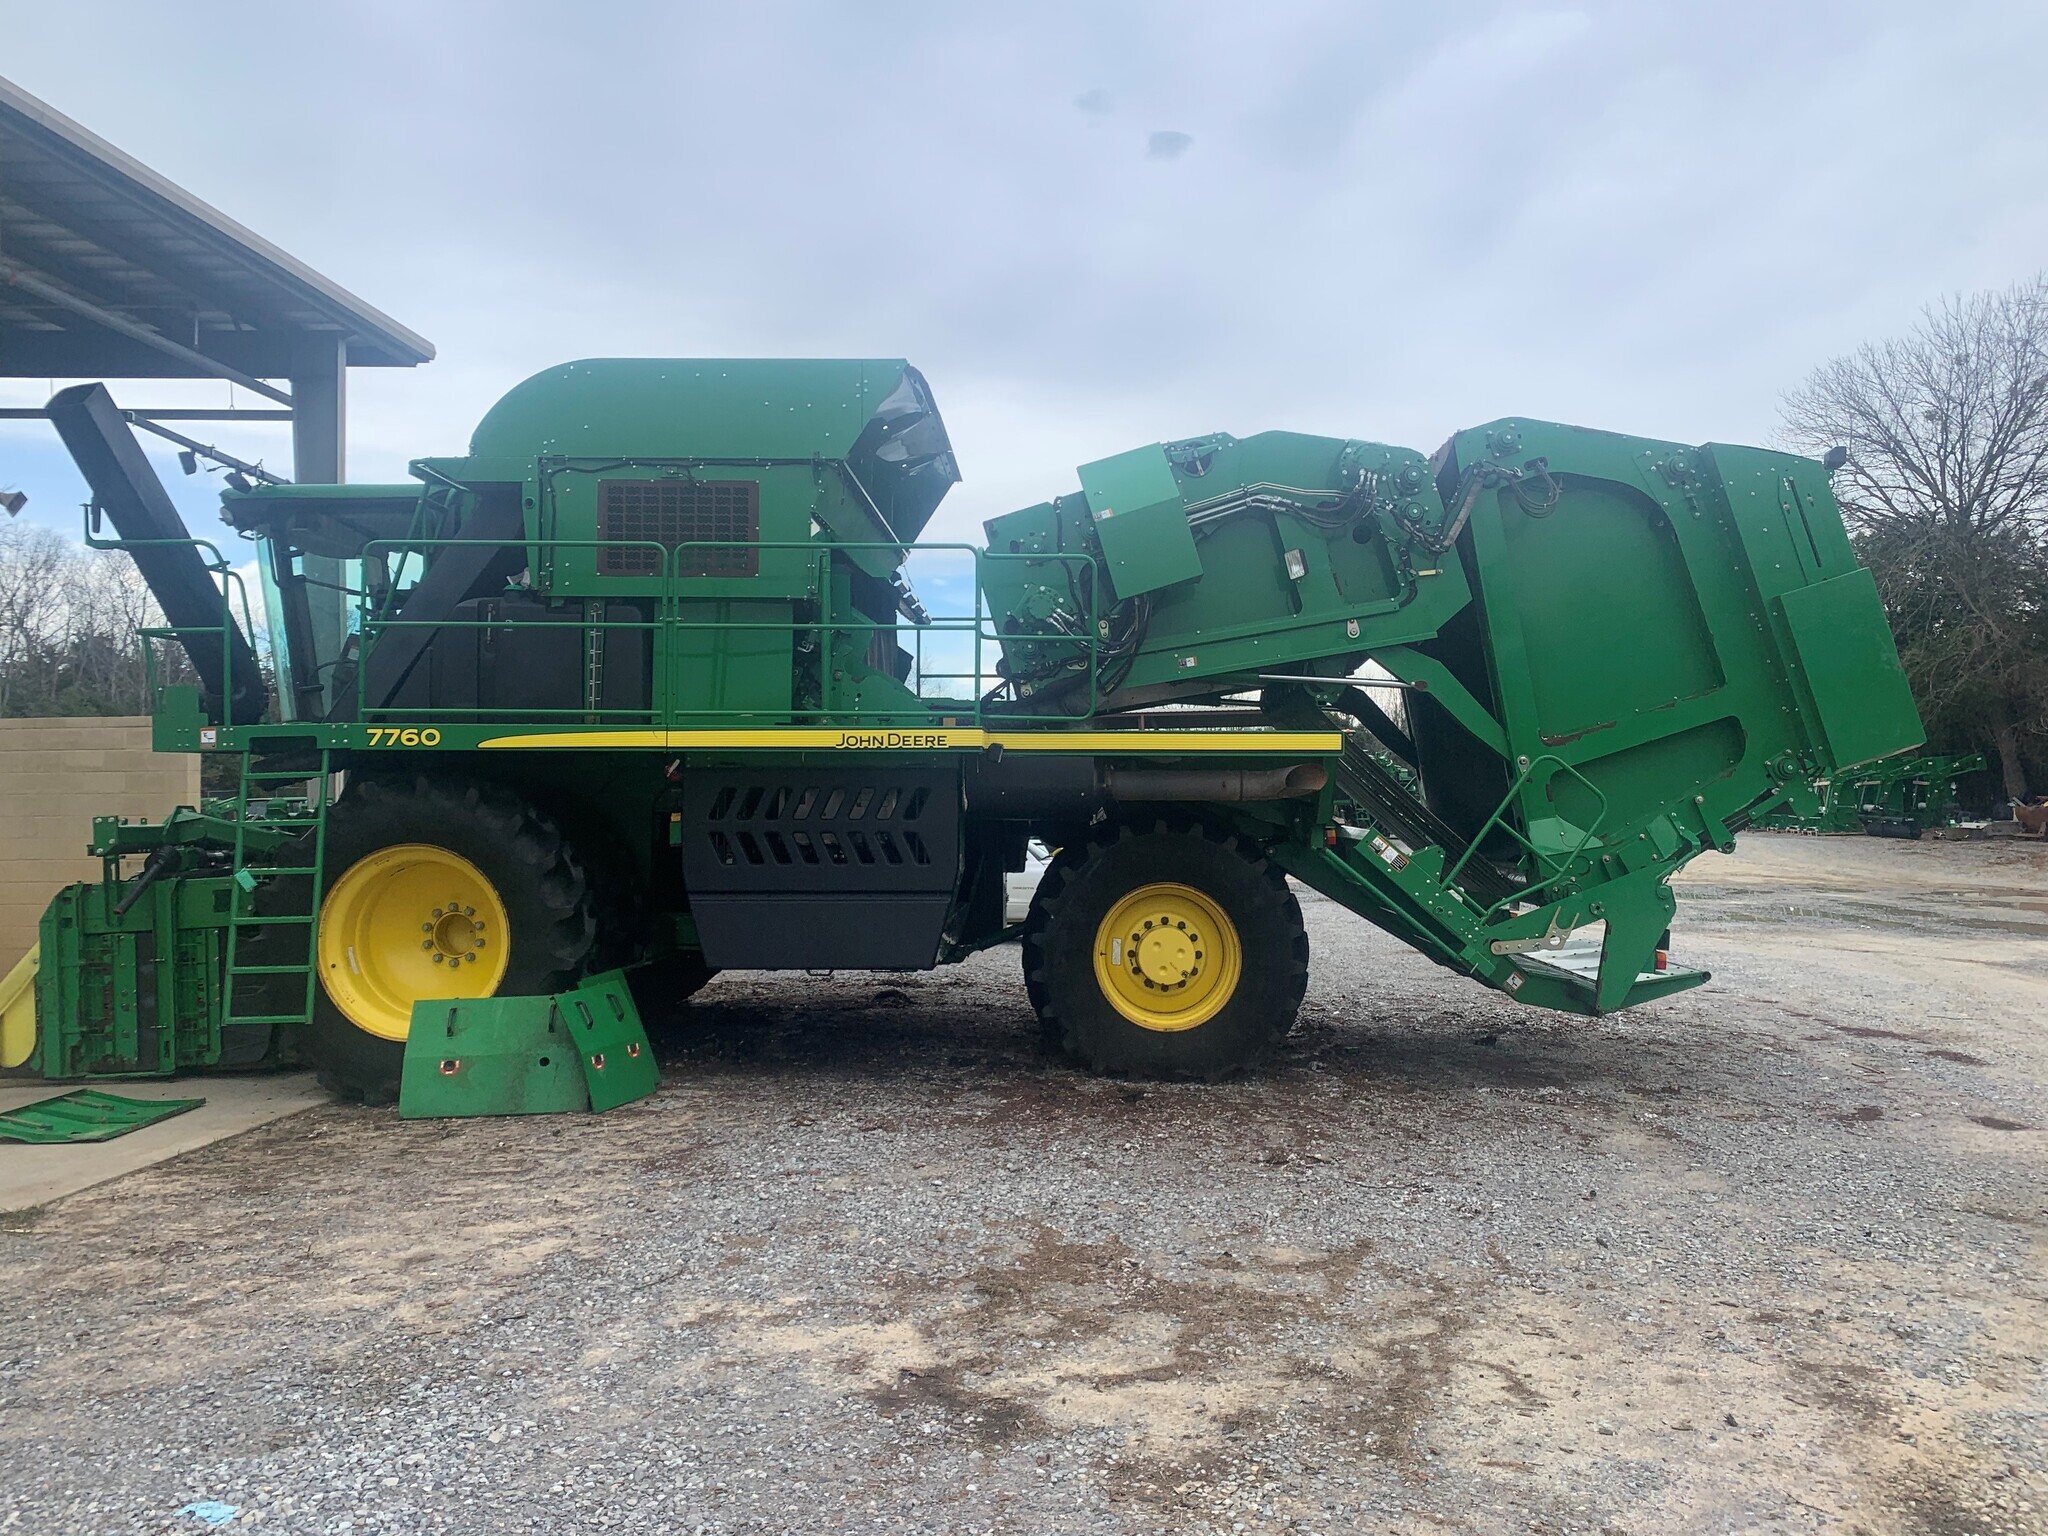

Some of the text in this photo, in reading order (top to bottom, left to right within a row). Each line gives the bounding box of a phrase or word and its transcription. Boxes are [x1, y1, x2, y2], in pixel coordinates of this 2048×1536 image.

[366, 728, 441, 747] 7760
[836, 733, 948, 747] JOHN DEERE
